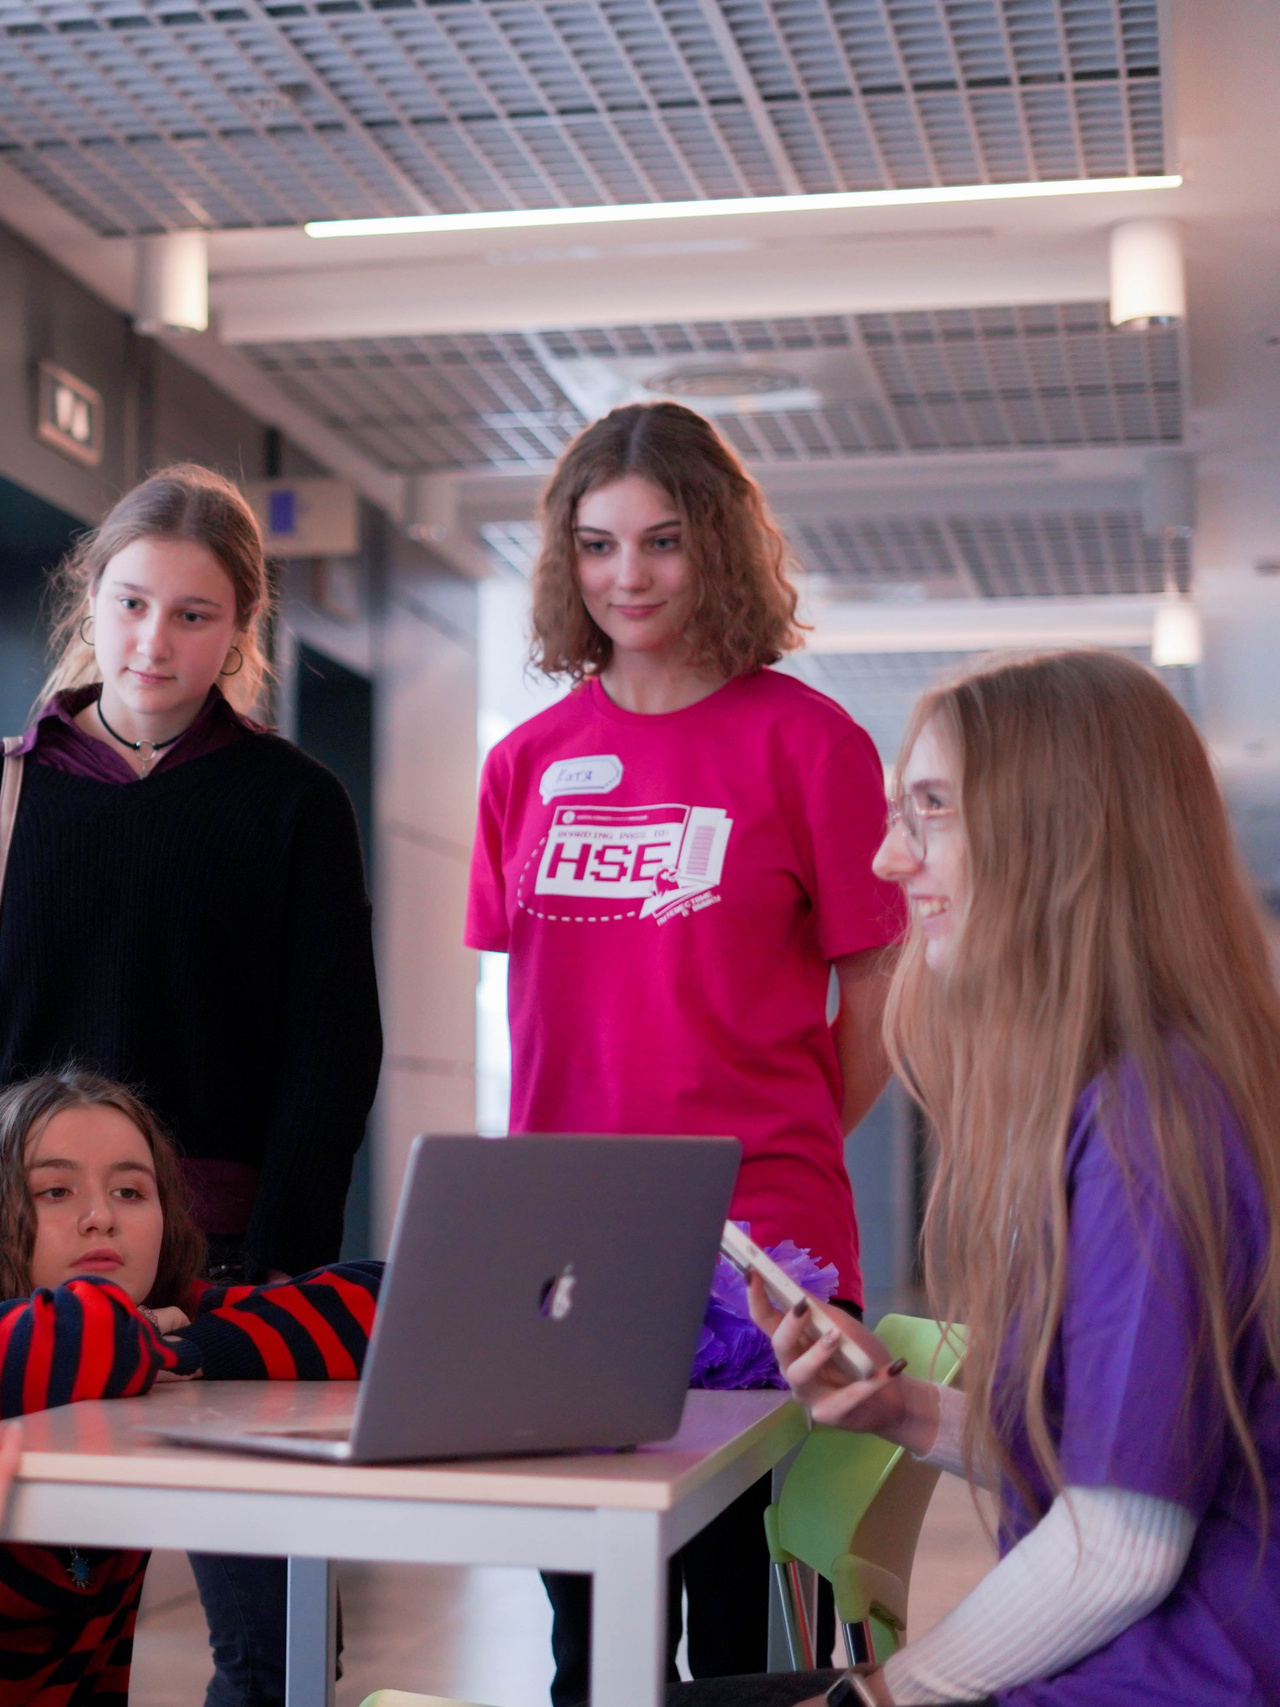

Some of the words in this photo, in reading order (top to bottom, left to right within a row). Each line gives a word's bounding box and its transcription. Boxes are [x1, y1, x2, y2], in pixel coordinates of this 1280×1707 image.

[555, 768, 592, 784] Катя
[557, 831, 614, 840] BOARDING
[546, 842, 671, 883] HSE
